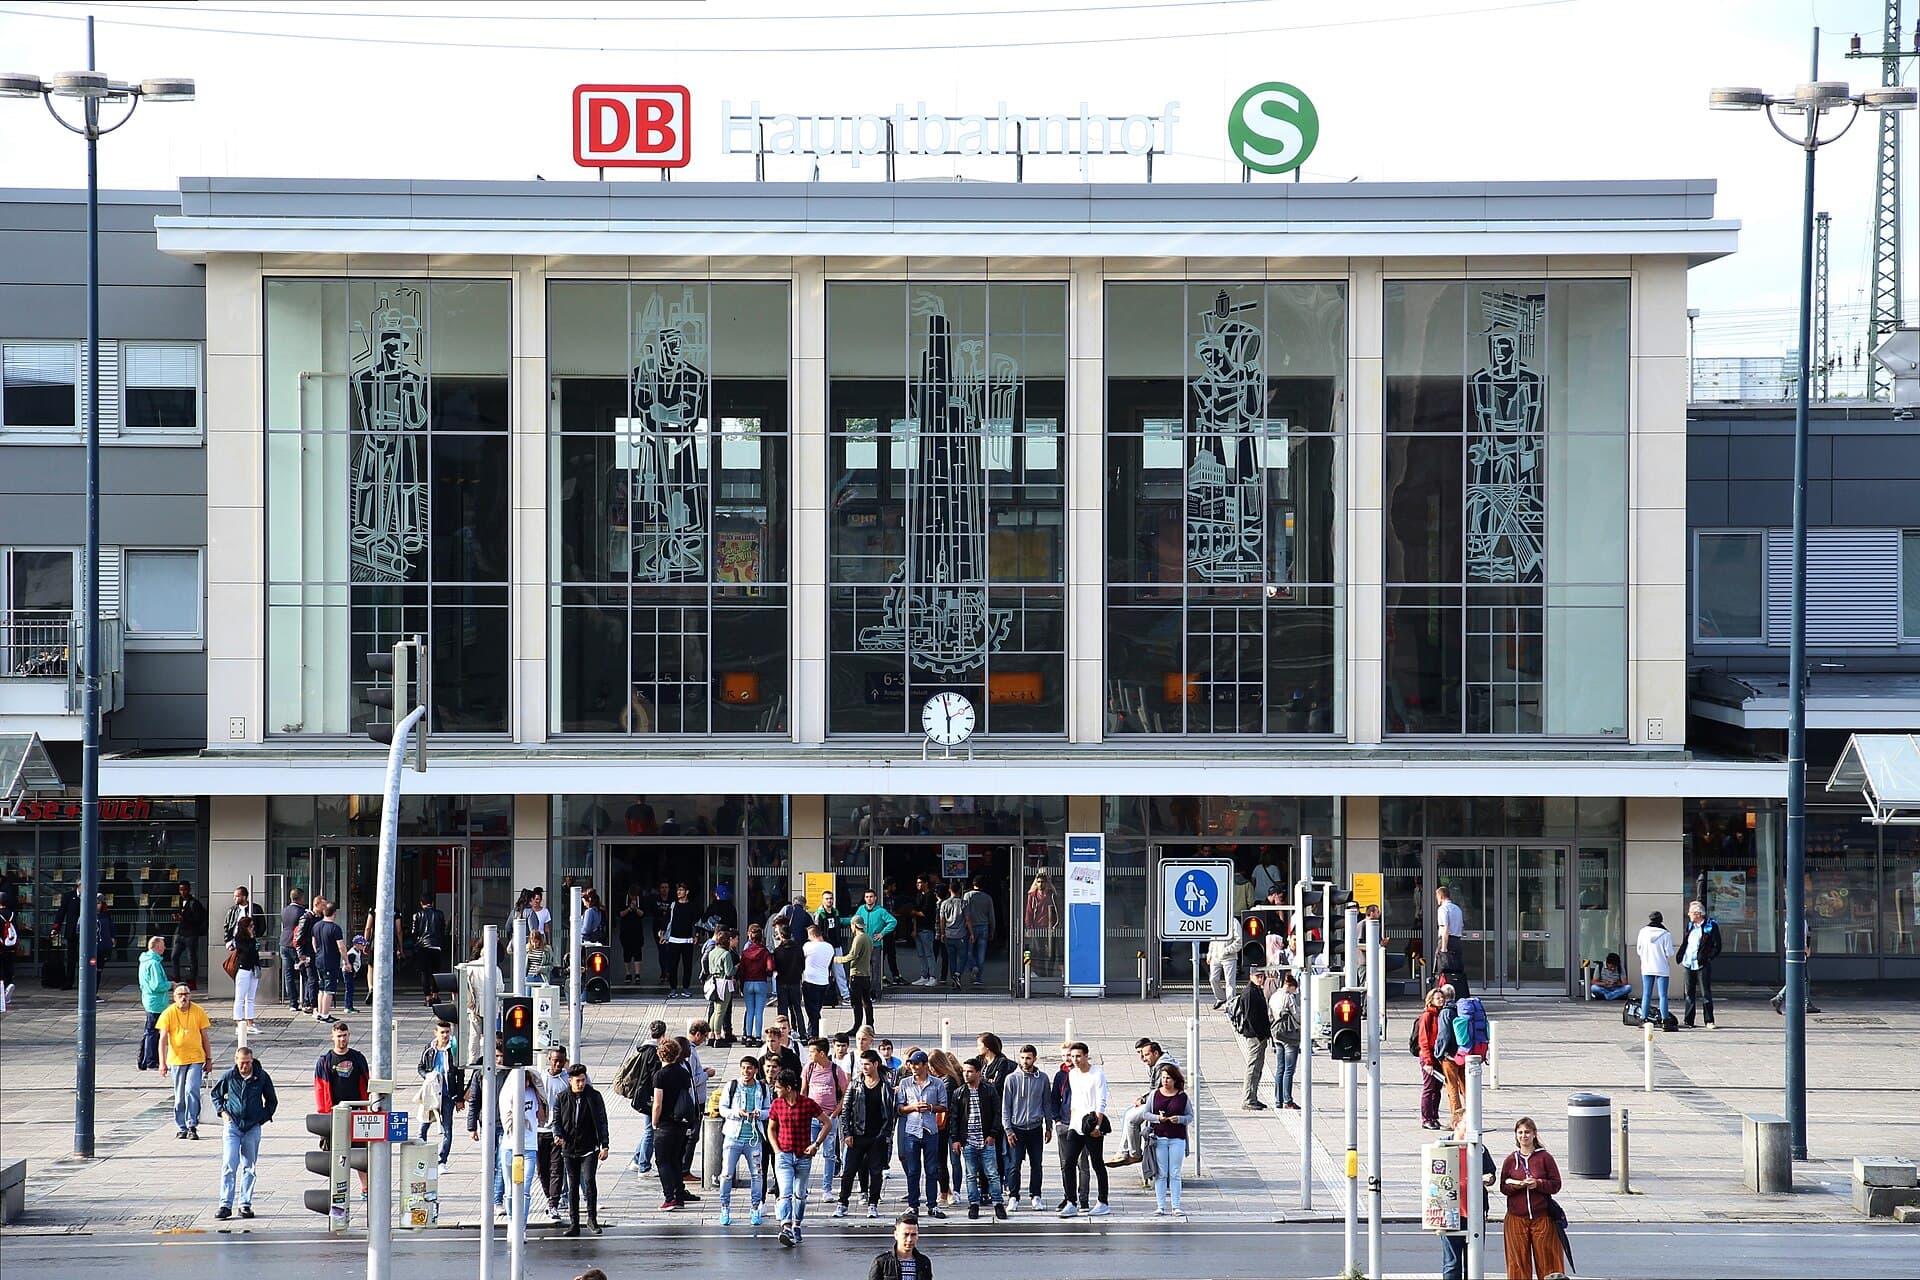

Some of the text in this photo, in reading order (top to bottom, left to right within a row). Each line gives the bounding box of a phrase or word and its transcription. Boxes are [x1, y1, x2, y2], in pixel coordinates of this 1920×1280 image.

[588, 98, 676, 153] DB
[721, 100, 1180, 168] Hauptbahnhof
[1242, 90, 1304, 166] S
[1180, 920, 1213, 932] ZONE
